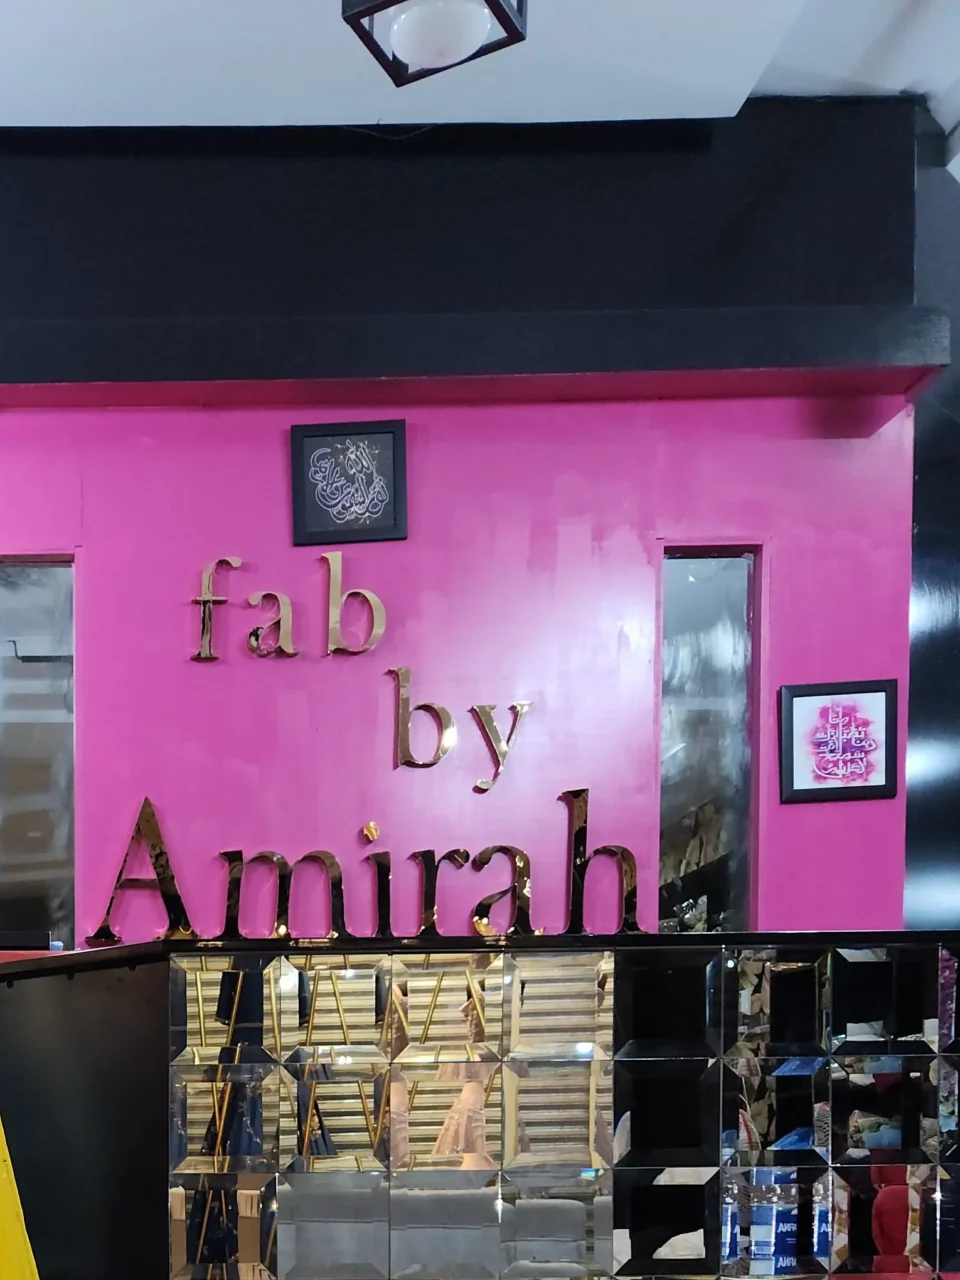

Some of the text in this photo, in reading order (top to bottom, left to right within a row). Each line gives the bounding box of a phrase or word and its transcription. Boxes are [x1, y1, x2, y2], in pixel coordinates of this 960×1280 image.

[190, 551, 386, 661] fab
[383, 666, 534, 794] by
[84, 788, 650, 946] Amirah
